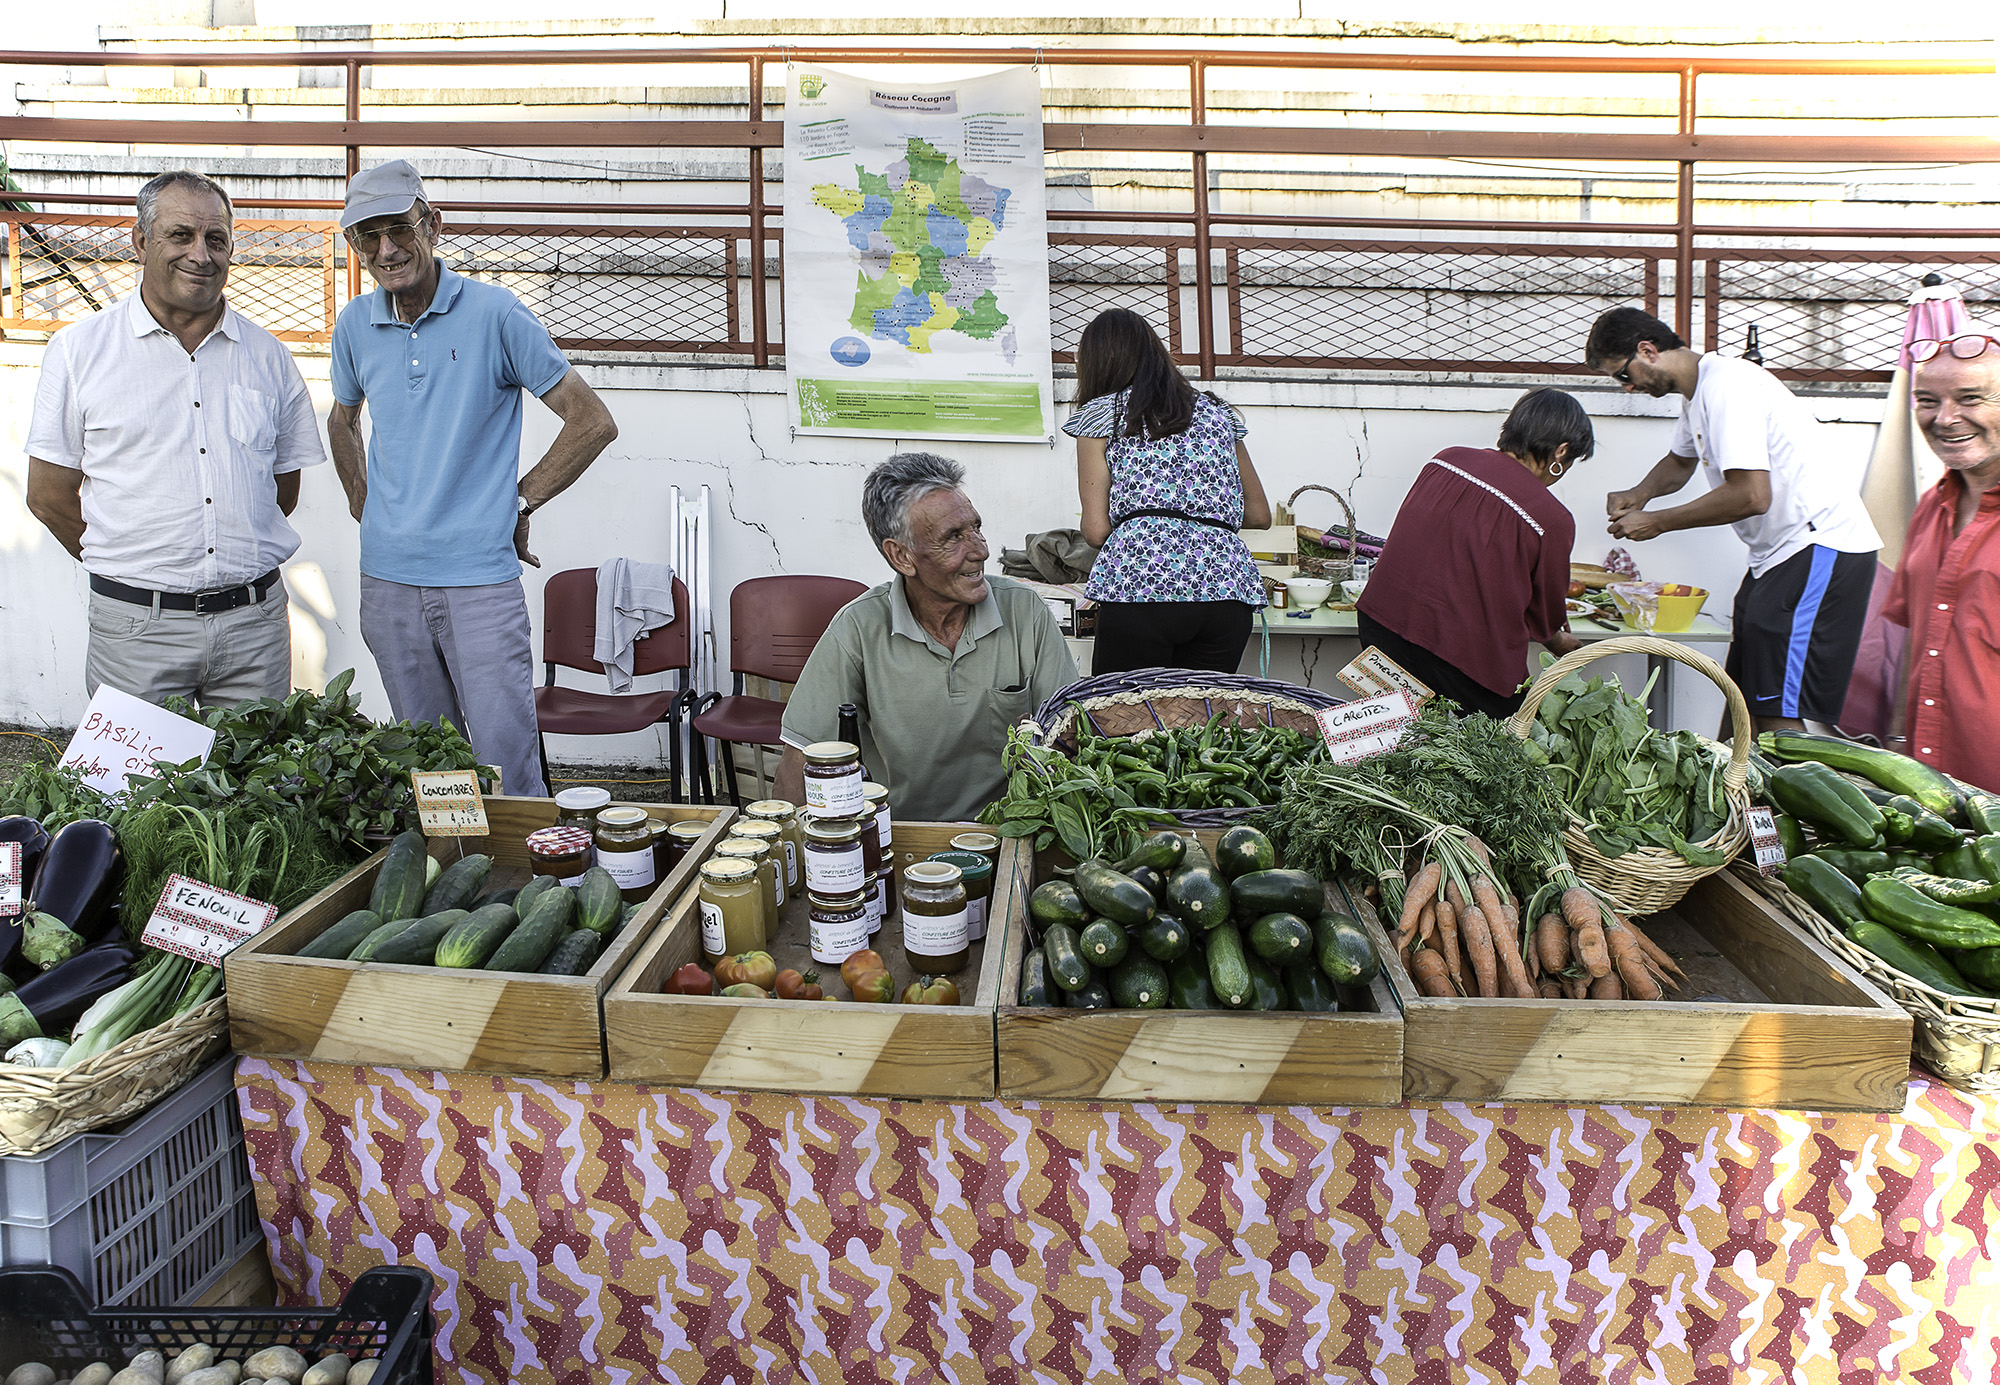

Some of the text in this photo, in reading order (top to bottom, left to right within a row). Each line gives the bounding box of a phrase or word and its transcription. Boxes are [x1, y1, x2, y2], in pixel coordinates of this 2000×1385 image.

[875, 92, 951, 104] Réseau Cocagne
[1332, 704, 1390, 727] CAROTTES
[701, 912, 718, 928] iel
[200, 935, 209, 947] 3
